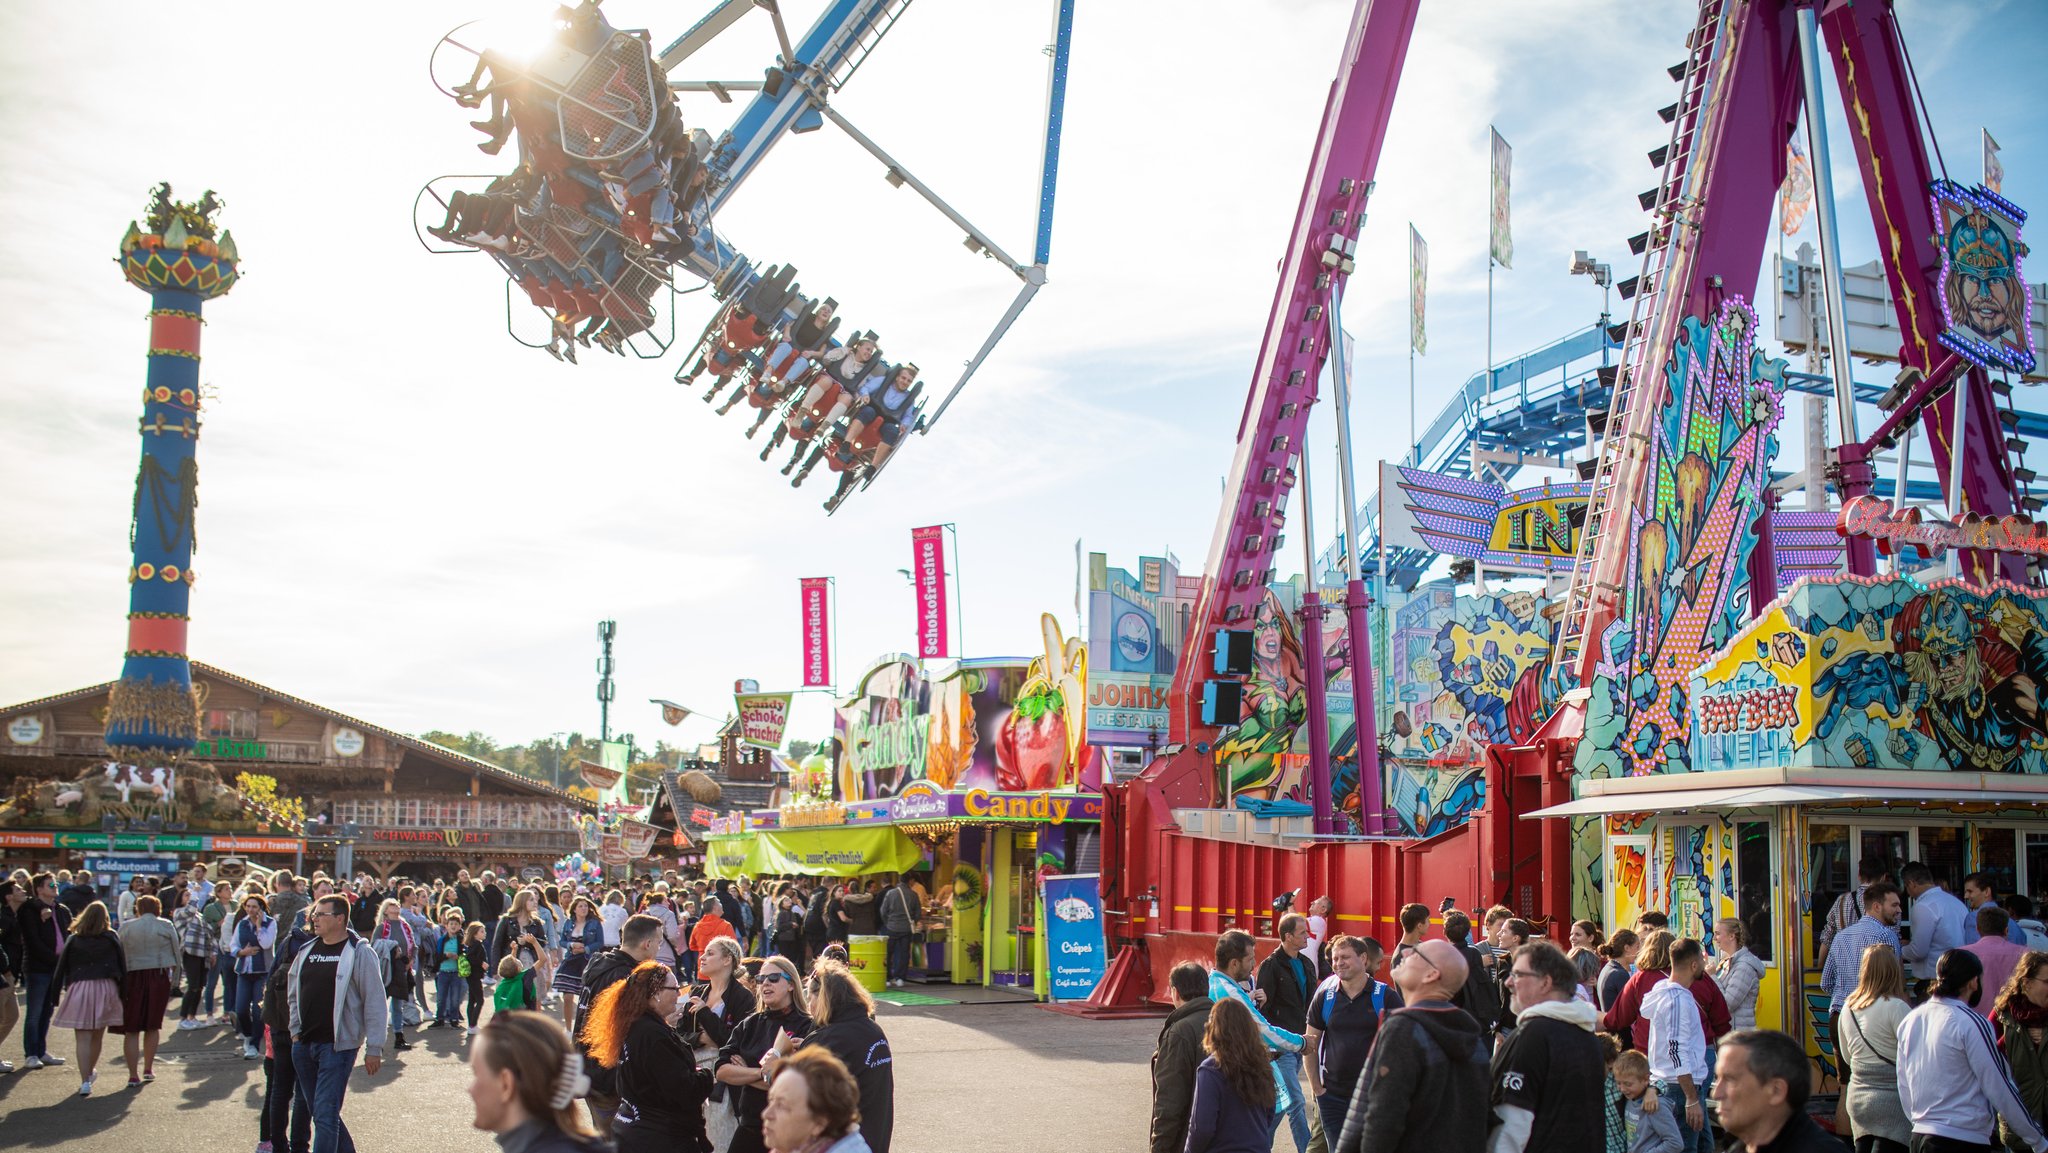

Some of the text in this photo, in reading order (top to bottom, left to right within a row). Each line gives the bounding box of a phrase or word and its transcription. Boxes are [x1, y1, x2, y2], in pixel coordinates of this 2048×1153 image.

[1965, 252, 1998, 268] GIANT
[922, 541, 939, 656] Schokofrüchte
[808, 590, 822, 684] Schokofrüchte
[744, 699, 786, 711] Candy
[1699, 685, 1800, 735] PAY BOX
[1095, 712, 1168, 729] RESTAUR
[217, 736, 267, 759] Bräu
[850, 700, 930, 779] Candy
[963, 788, 1073, 826] Candy
[11, 836, 50, 845] Trachten
[268, 841, 299, 851] Trachte
[96, 859, 160, 872] Geldautomat
[1684, 903, 1692, 937] HOTEL
[1061, 941, 1093, 956] Crêpes
[317, 953, 341, 963] humm
